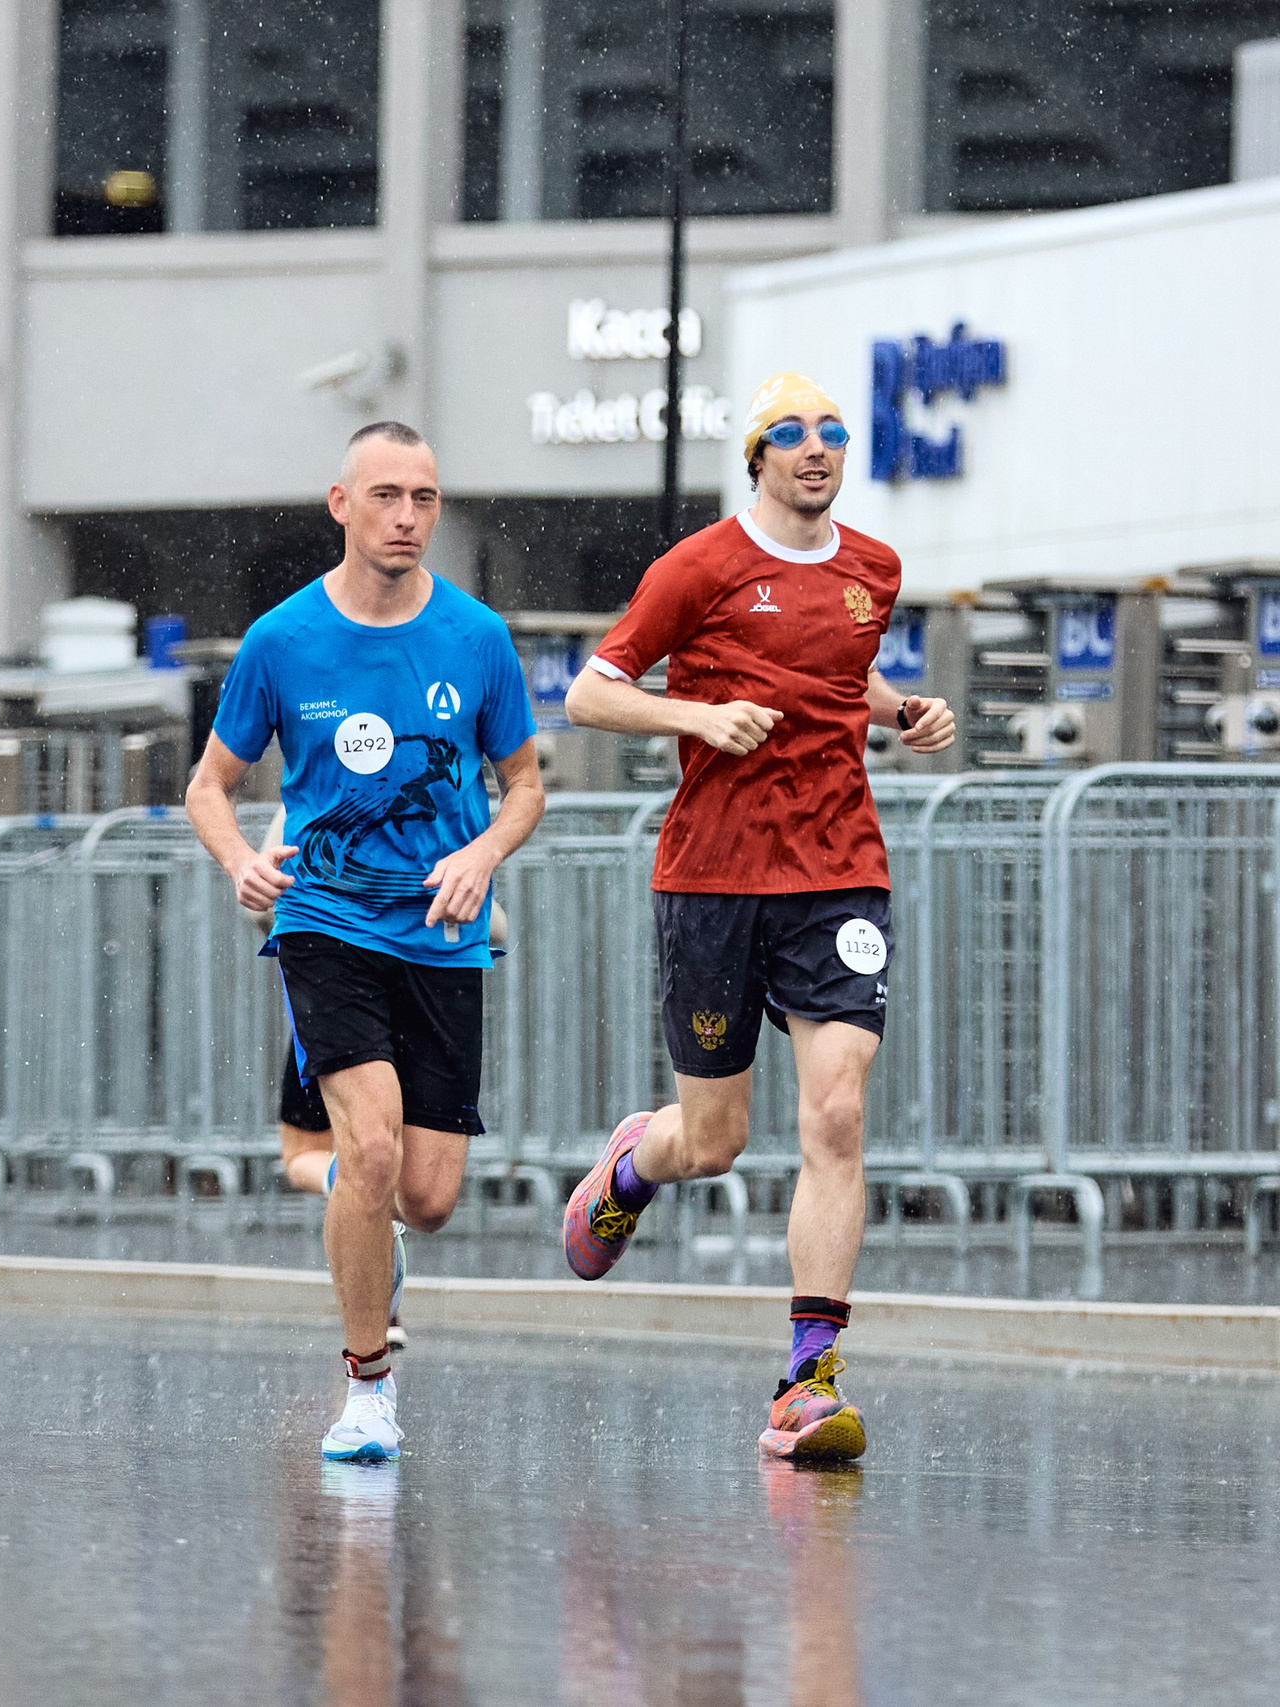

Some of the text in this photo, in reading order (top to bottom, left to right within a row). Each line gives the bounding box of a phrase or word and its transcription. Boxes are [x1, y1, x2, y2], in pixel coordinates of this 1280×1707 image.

[299, 701, 330, 711] БЕЖИМ
[300, 708, 348, 721] АКСИОМОЙ
[343, 737, 387, 753] 1292
[846, 940, 880, 956] 1132
